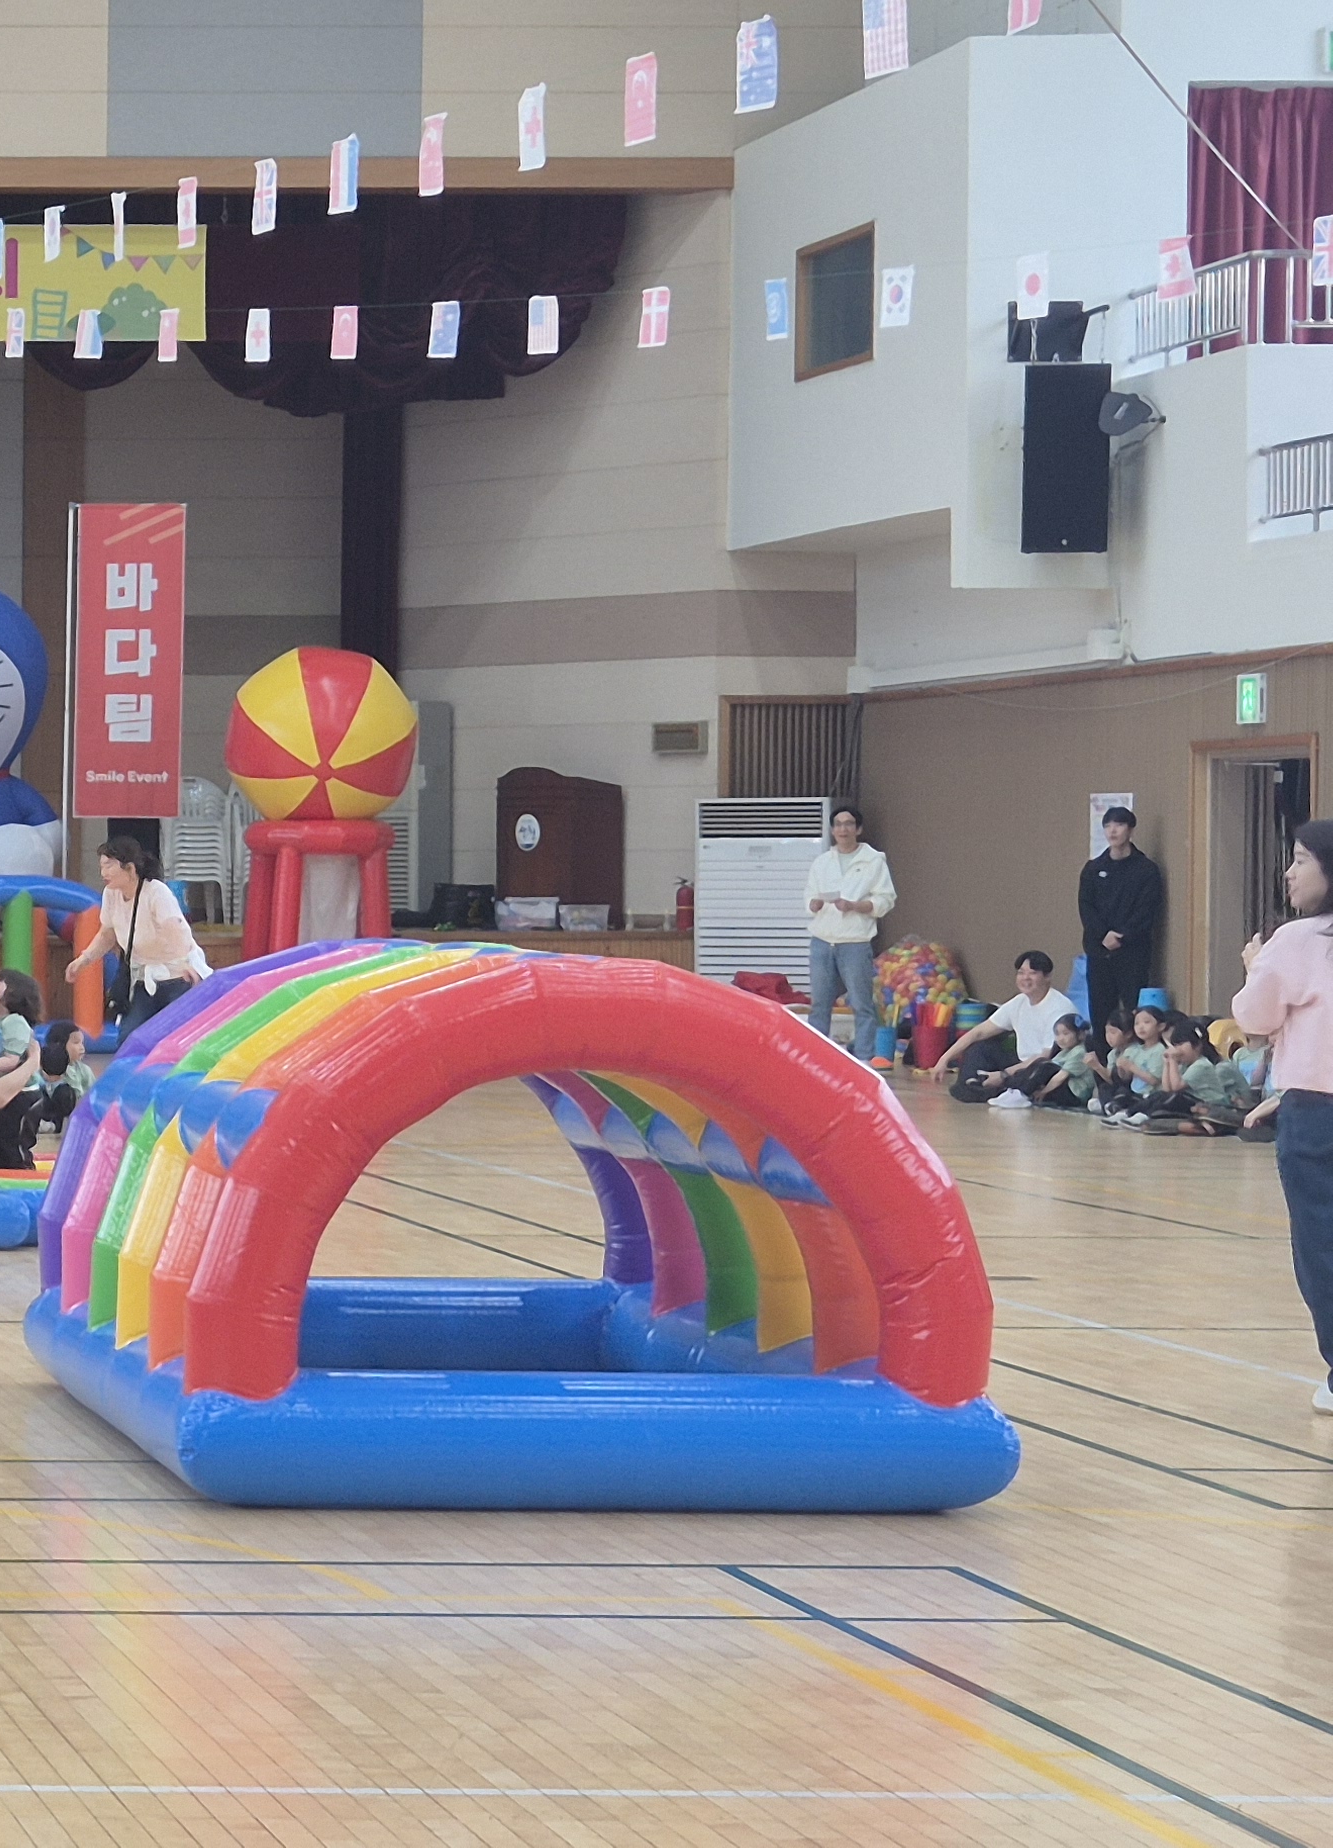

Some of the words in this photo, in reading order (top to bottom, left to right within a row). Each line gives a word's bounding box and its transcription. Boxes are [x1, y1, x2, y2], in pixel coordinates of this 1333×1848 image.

[104, 562, 159, 743] 바다팀
[85, 769, 125, 783] Smile
[127, 769, 169, 783] Event
